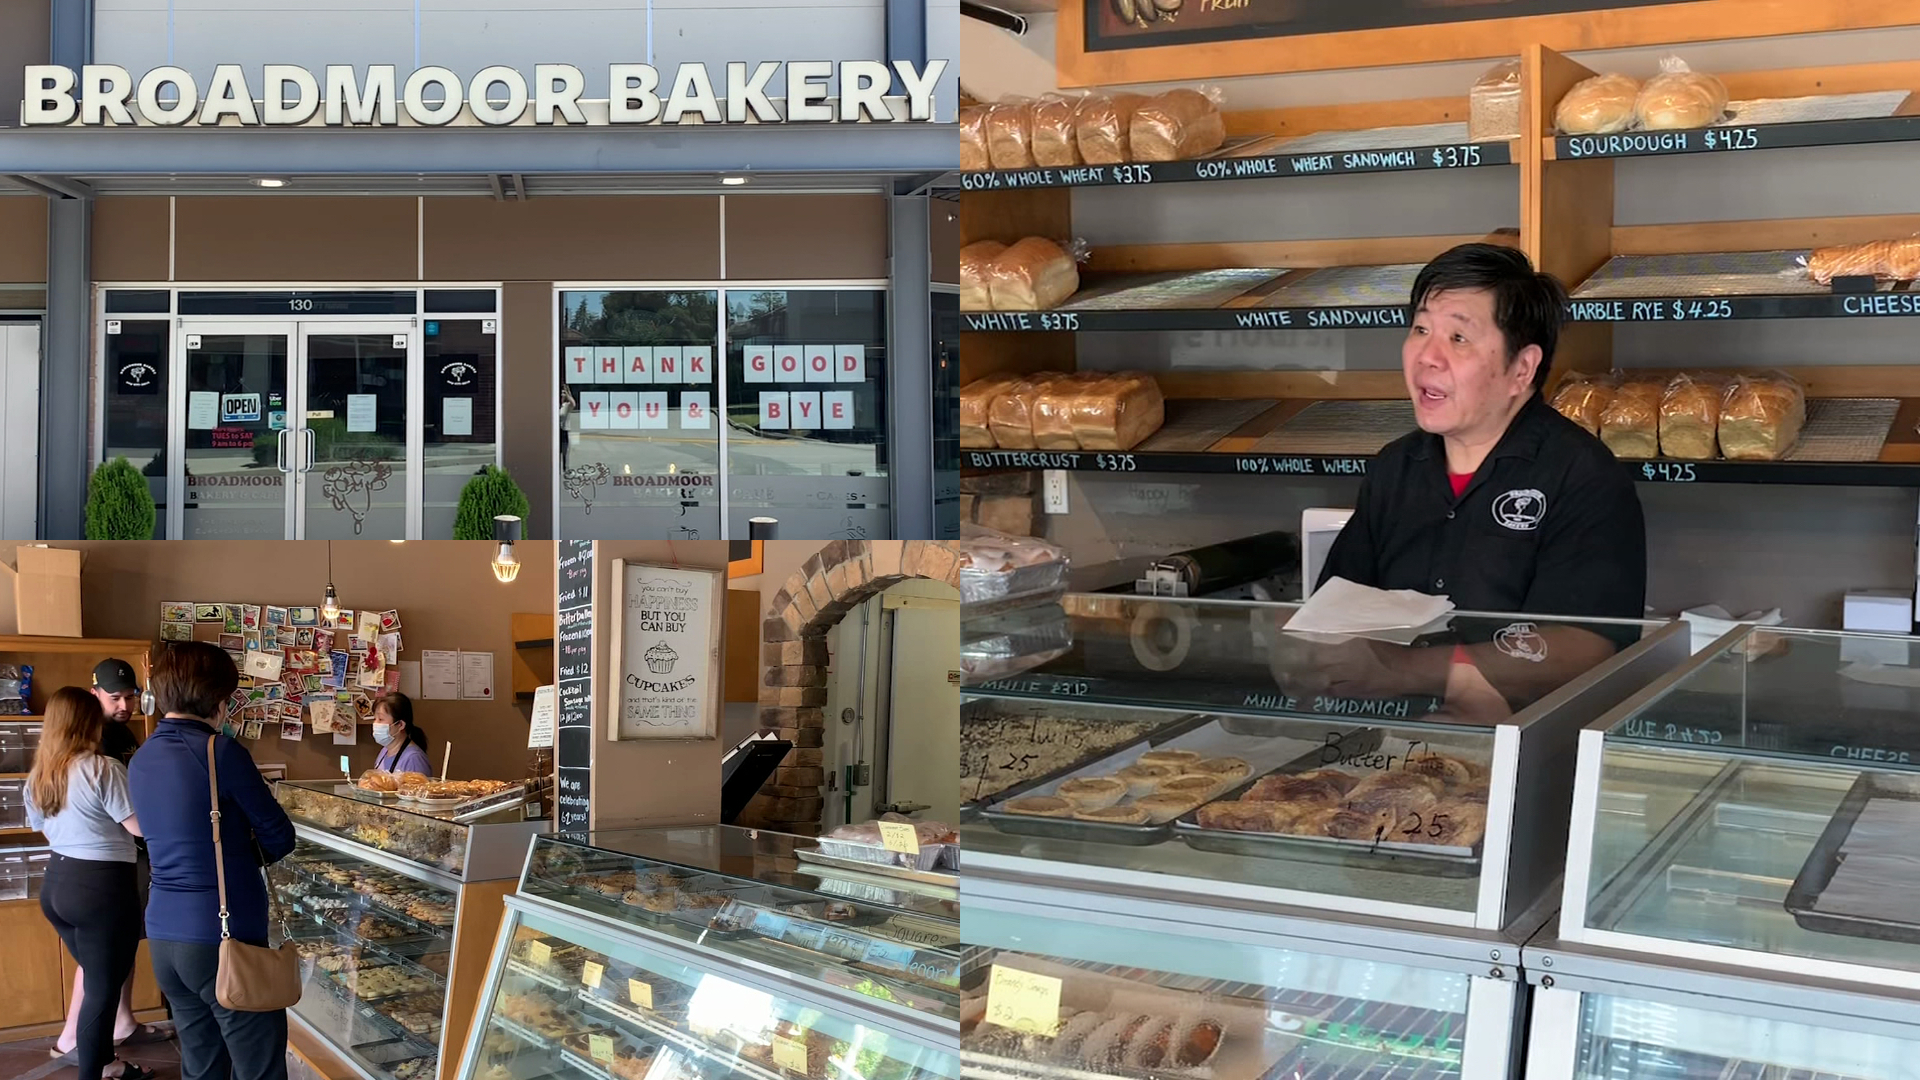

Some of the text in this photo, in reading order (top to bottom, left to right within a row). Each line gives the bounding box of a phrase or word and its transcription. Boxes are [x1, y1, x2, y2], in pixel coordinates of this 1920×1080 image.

[23, 58, 949, 126] BROADMOOR BAKERY
[1569, 129, 1758, 157] SOURDOUGH $4.25
[1196, 146, 1480, 178] 60% WHOLE WHEAT SANDWICH $3.75
[962, 165, 1152, 190] 60% WHOLE WHEAT $3.75
[289, 299, 313, 311] 130
[1632, 302, 1662, 320] RYE
[966, 313, 1079, 331] WHITE $3.75
[1236, 308, 1405, 327] WHITE SANDWICH
[573, 356, 705, 374] THANK
[751, 354, 857, 372] GOOD
[227, 398, 257, 414] OPEN
[589, 402, 704, 419] YOU &
[768, 402, 843, 420] BYE
[970, 452, 1137, 471] BUTTERCRUST $3.75
[1236, 457, 1367, 473] 100% WHOLE WHEAT
[1642, 462, 1696, 481] $4.25
[188, 476, 282, 486] BROADMOOR
[613, 475, 714, 487] BROADMOOR
[559, 556, 577, 569] Frozen
[559, 589, 576, 603] Fried
[675, 587, 689, 595] buy
[629, 594, 698, 611] HAPPINESS
[641, 610, 686, 622] BUT YOU
[640, 621, 687, 633] CAN BUY
[559, 631, 578, 642] Frozen
[560, 663, 588, 676] Fried $12
[559, 684, 582, 697] Cocktail
[626, 673, 695, 693] CUPCAKES
[627, 705, 696, 719] SAME THING
[1319, 731, 1398, 772] Butter
[560, 776, 581, 790] We are
[560, 795, 589, 812] celebrating
